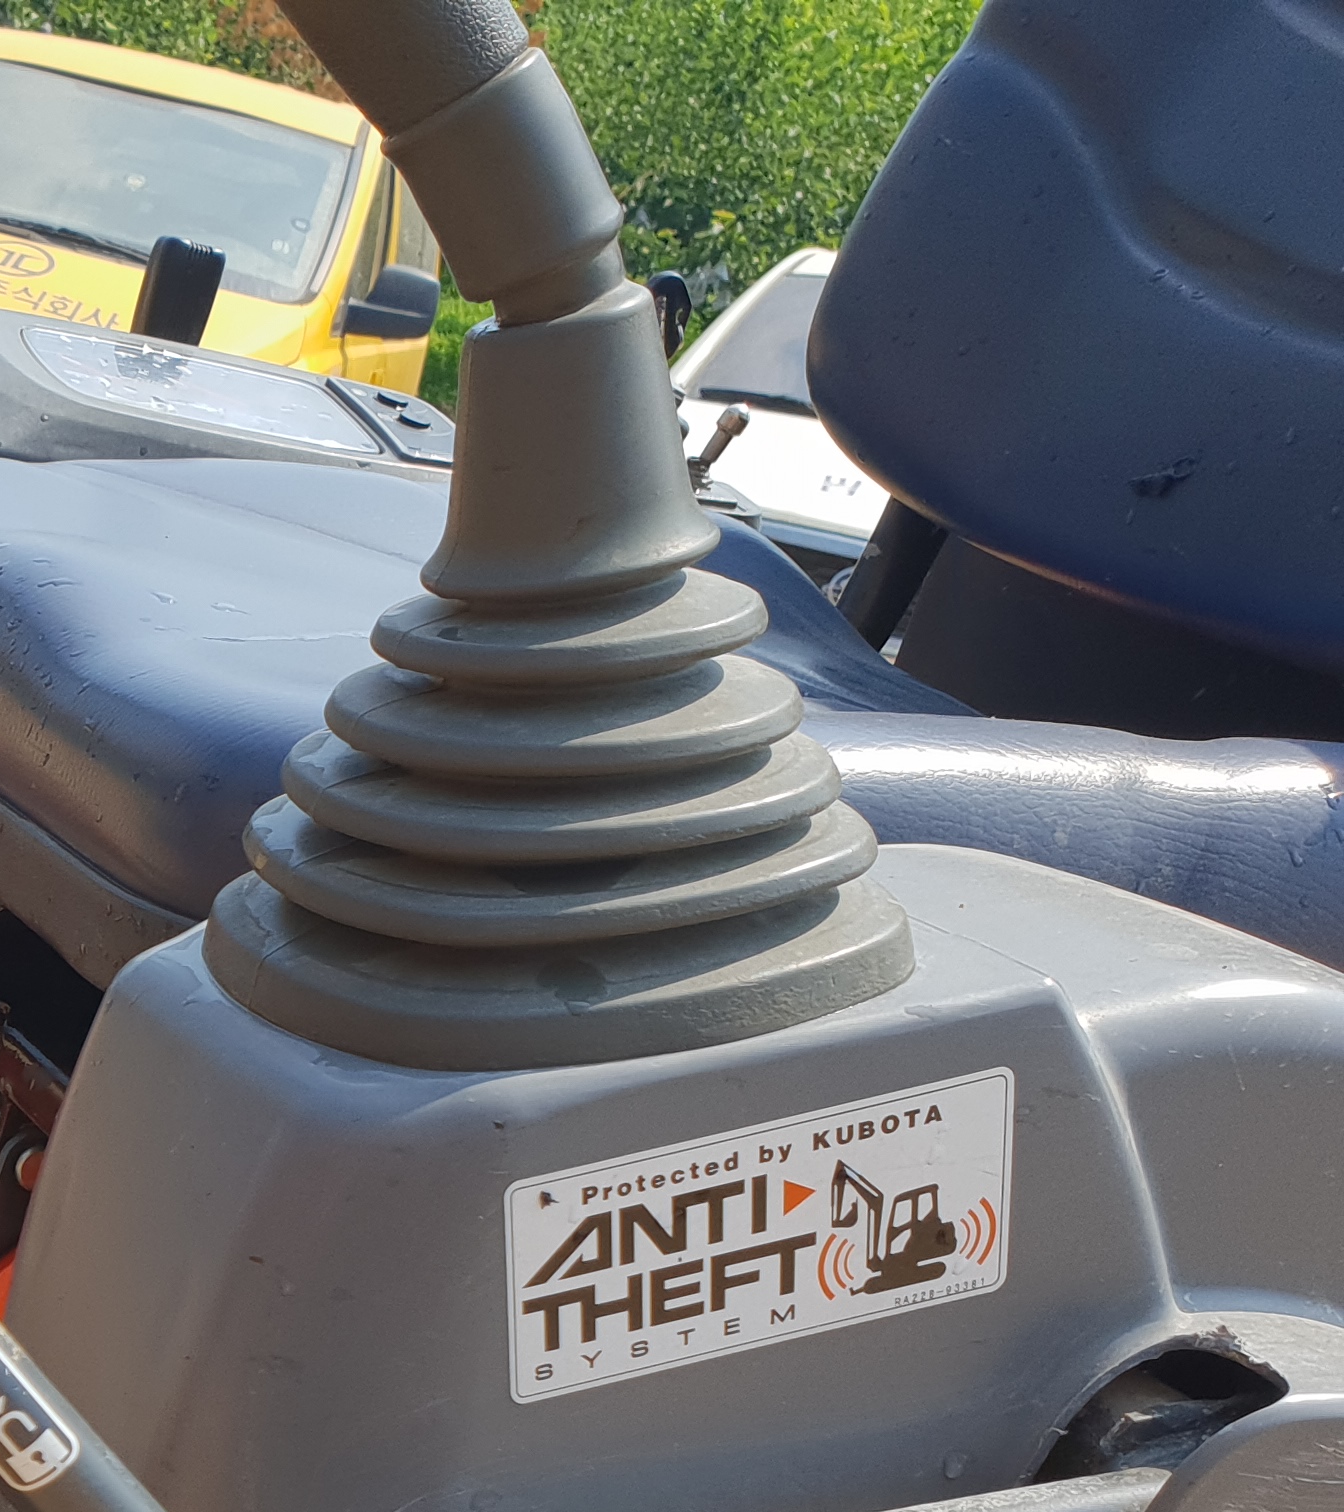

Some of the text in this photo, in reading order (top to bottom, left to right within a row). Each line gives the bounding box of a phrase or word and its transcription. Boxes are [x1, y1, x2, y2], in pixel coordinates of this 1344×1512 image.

[582, 1105, 943, 1205] Protected by KUBOTA
[523, 1173, 768, 1289] ANTI
[523, 1232, 817, 1352] THEFT
